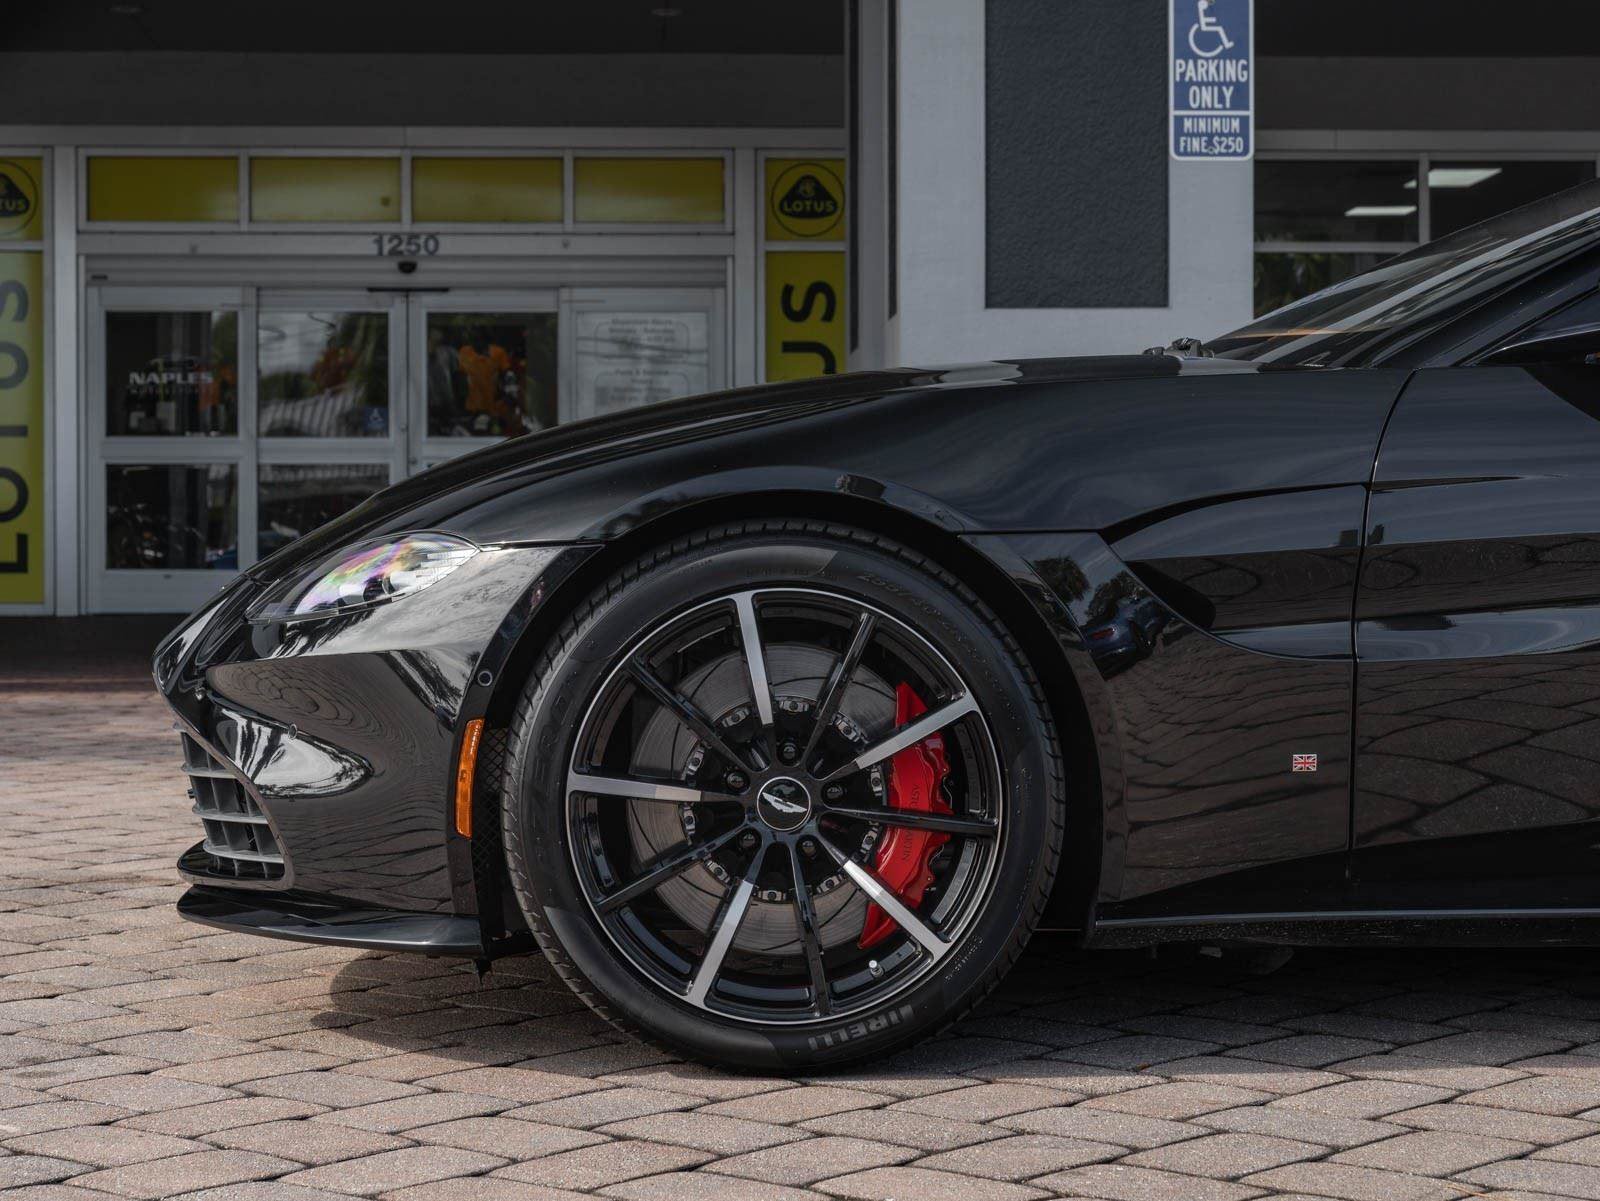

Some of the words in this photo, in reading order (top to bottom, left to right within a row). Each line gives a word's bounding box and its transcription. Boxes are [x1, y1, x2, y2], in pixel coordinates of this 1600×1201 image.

[1175, 59, 1248, 82] PARKING
[1189, 85, 1234, 109] ONLY
[1183, 117, 1240, 134] MINIMUM
[783, 199, 835, 213] LOTUS
[373, 233, 440, 257] 1250
[129, 371, 214, 385] NAPLES
